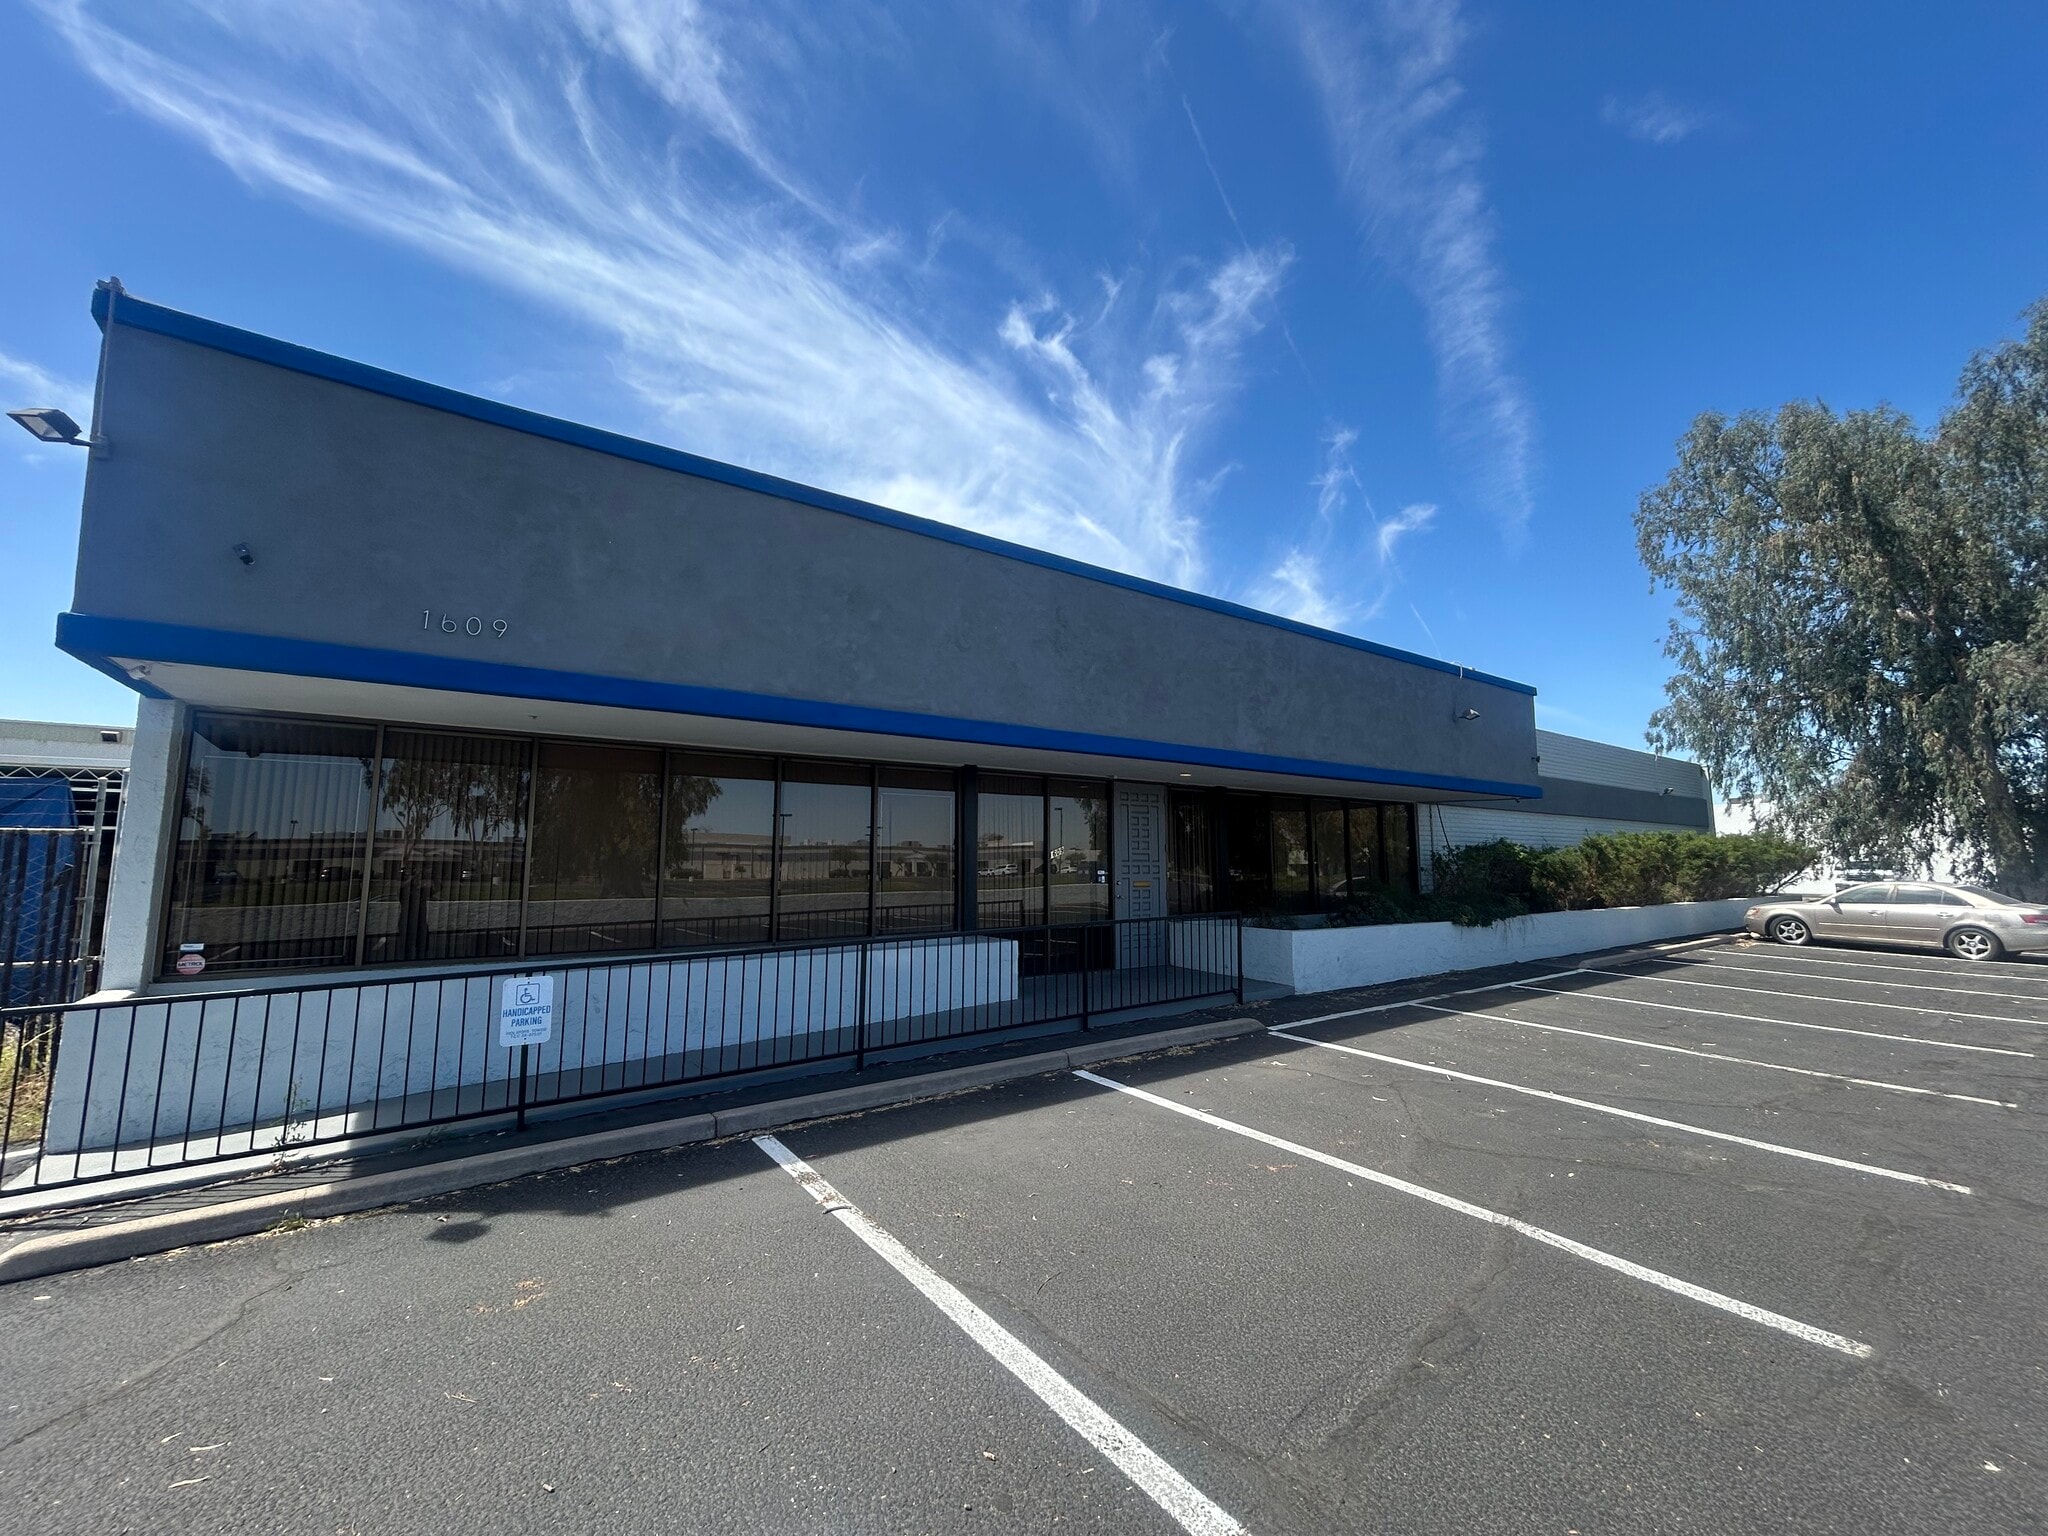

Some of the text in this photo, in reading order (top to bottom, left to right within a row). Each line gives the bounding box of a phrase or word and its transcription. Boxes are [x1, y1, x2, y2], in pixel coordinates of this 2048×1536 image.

[423, 610, 508, 638] 1609
[502, 1005, 551, 1018] HANDICAPPED
[511, 1016, 542, 1027] PARKING
